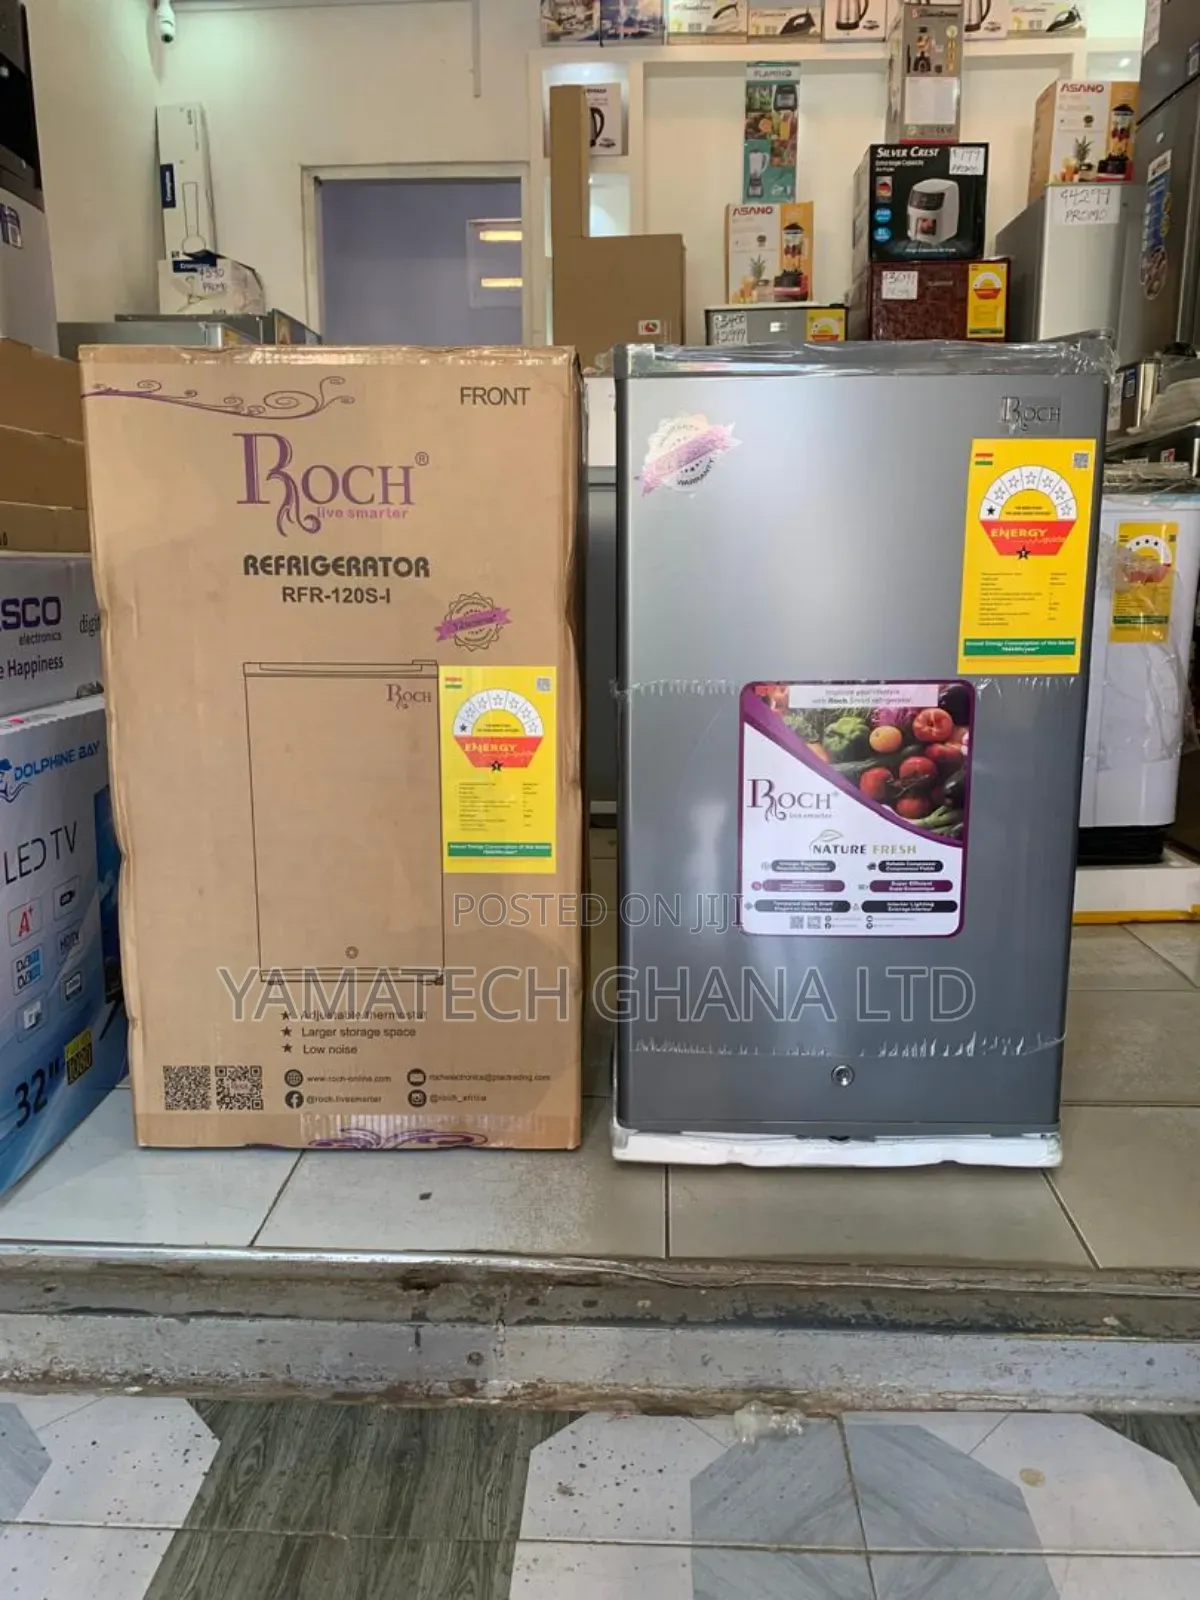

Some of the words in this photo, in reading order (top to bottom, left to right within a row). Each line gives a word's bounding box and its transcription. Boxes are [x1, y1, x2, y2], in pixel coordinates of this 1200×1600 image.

[1060, 83, 1104, 94] ASANO
[876, 147, 908, 158] SILVER
[910, 146, 940, 158] CREST
[732, 206, 773, 216] ASANO
[1065, 208, 1108, 224] PROMO
[459, 387, 531, 406] FRONT
[1001, 396, 1060, 432] ROCH
[317, 507, 343, 519] live
[347, 507, 409, 520] smarter
[990, 528, 1048, 540] ENERGY
[243, 554, 431, 578] REFRIGERATOR
[281, 585, 391, 604] RFR-120S-I
[0, 595, 62, 631] SCO
[19, 631, 62, 646] electronics
[7, 654, 64, 680] Happiness
[386, 684, 433, 710] ROCH
[464, 743, 518, 754] ENERGY
[14, 749, 77, 782] DOLPHINE
[78, 740, 101, 760] BAY
[4, 838, 47, 885] LED
[50, 820, 77, 861] TV
[812, 843, 867, 855] NATURE
[872, 843, 917, 855] FRESH
[300, 1009, 361, 1022] Adjustable
[301, 1027, 337, 1039] Larger
[340, 1027, 380, 1039] storage
[383, 1028, 417, 1039] space
[303, 1045, 325, 1054] Low
[328, 1045, 358, 1054] noise
